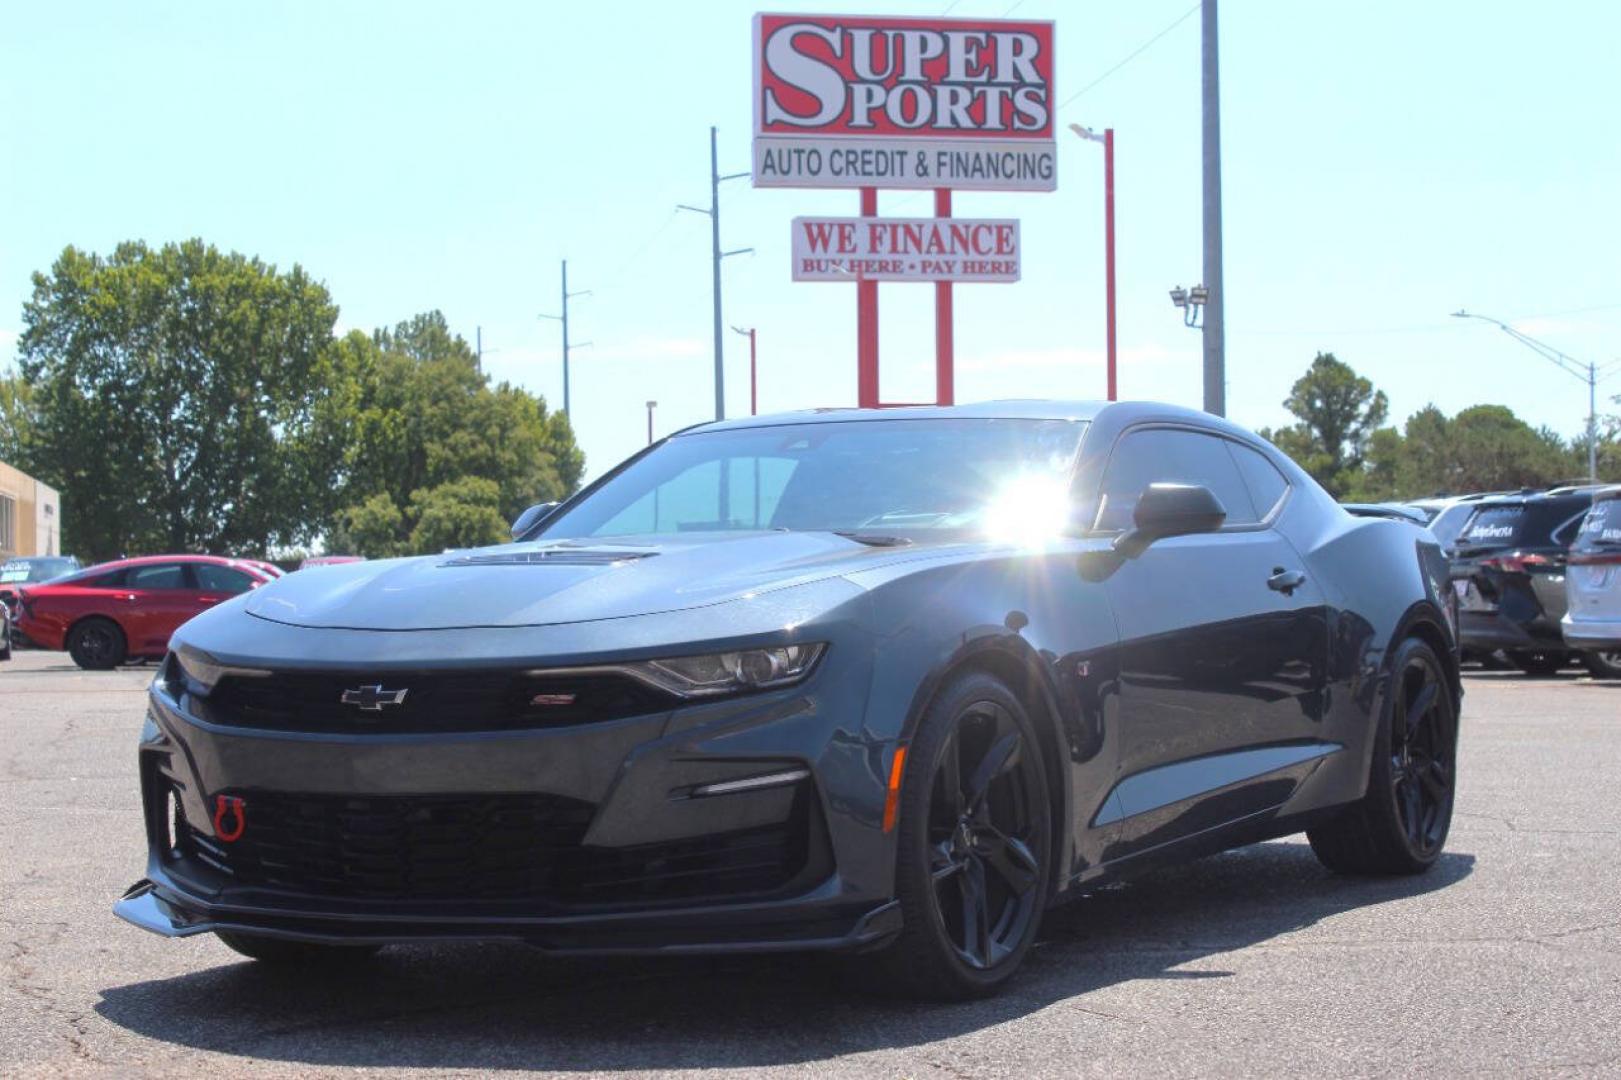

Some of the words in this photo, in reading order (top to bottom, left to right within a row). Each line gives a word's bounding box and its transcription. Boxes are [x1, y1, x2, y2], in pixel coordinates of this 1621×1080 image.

[761, 148, 822, 176] AUTO
[829, 149, 908, 178] CREDIT
[915, 151, 930, 178] &
[936, 151, 1052, 179] FINANCING
[803, 222, 857, 254] WE
[867, 223, 1016, 256] FINANCE
[802, 258, 844, 274] BUY
[850, 258, 904, 274] HERE
[920, 259, 958, 274] PAY
[961, 260, 1018, 275] HERE
